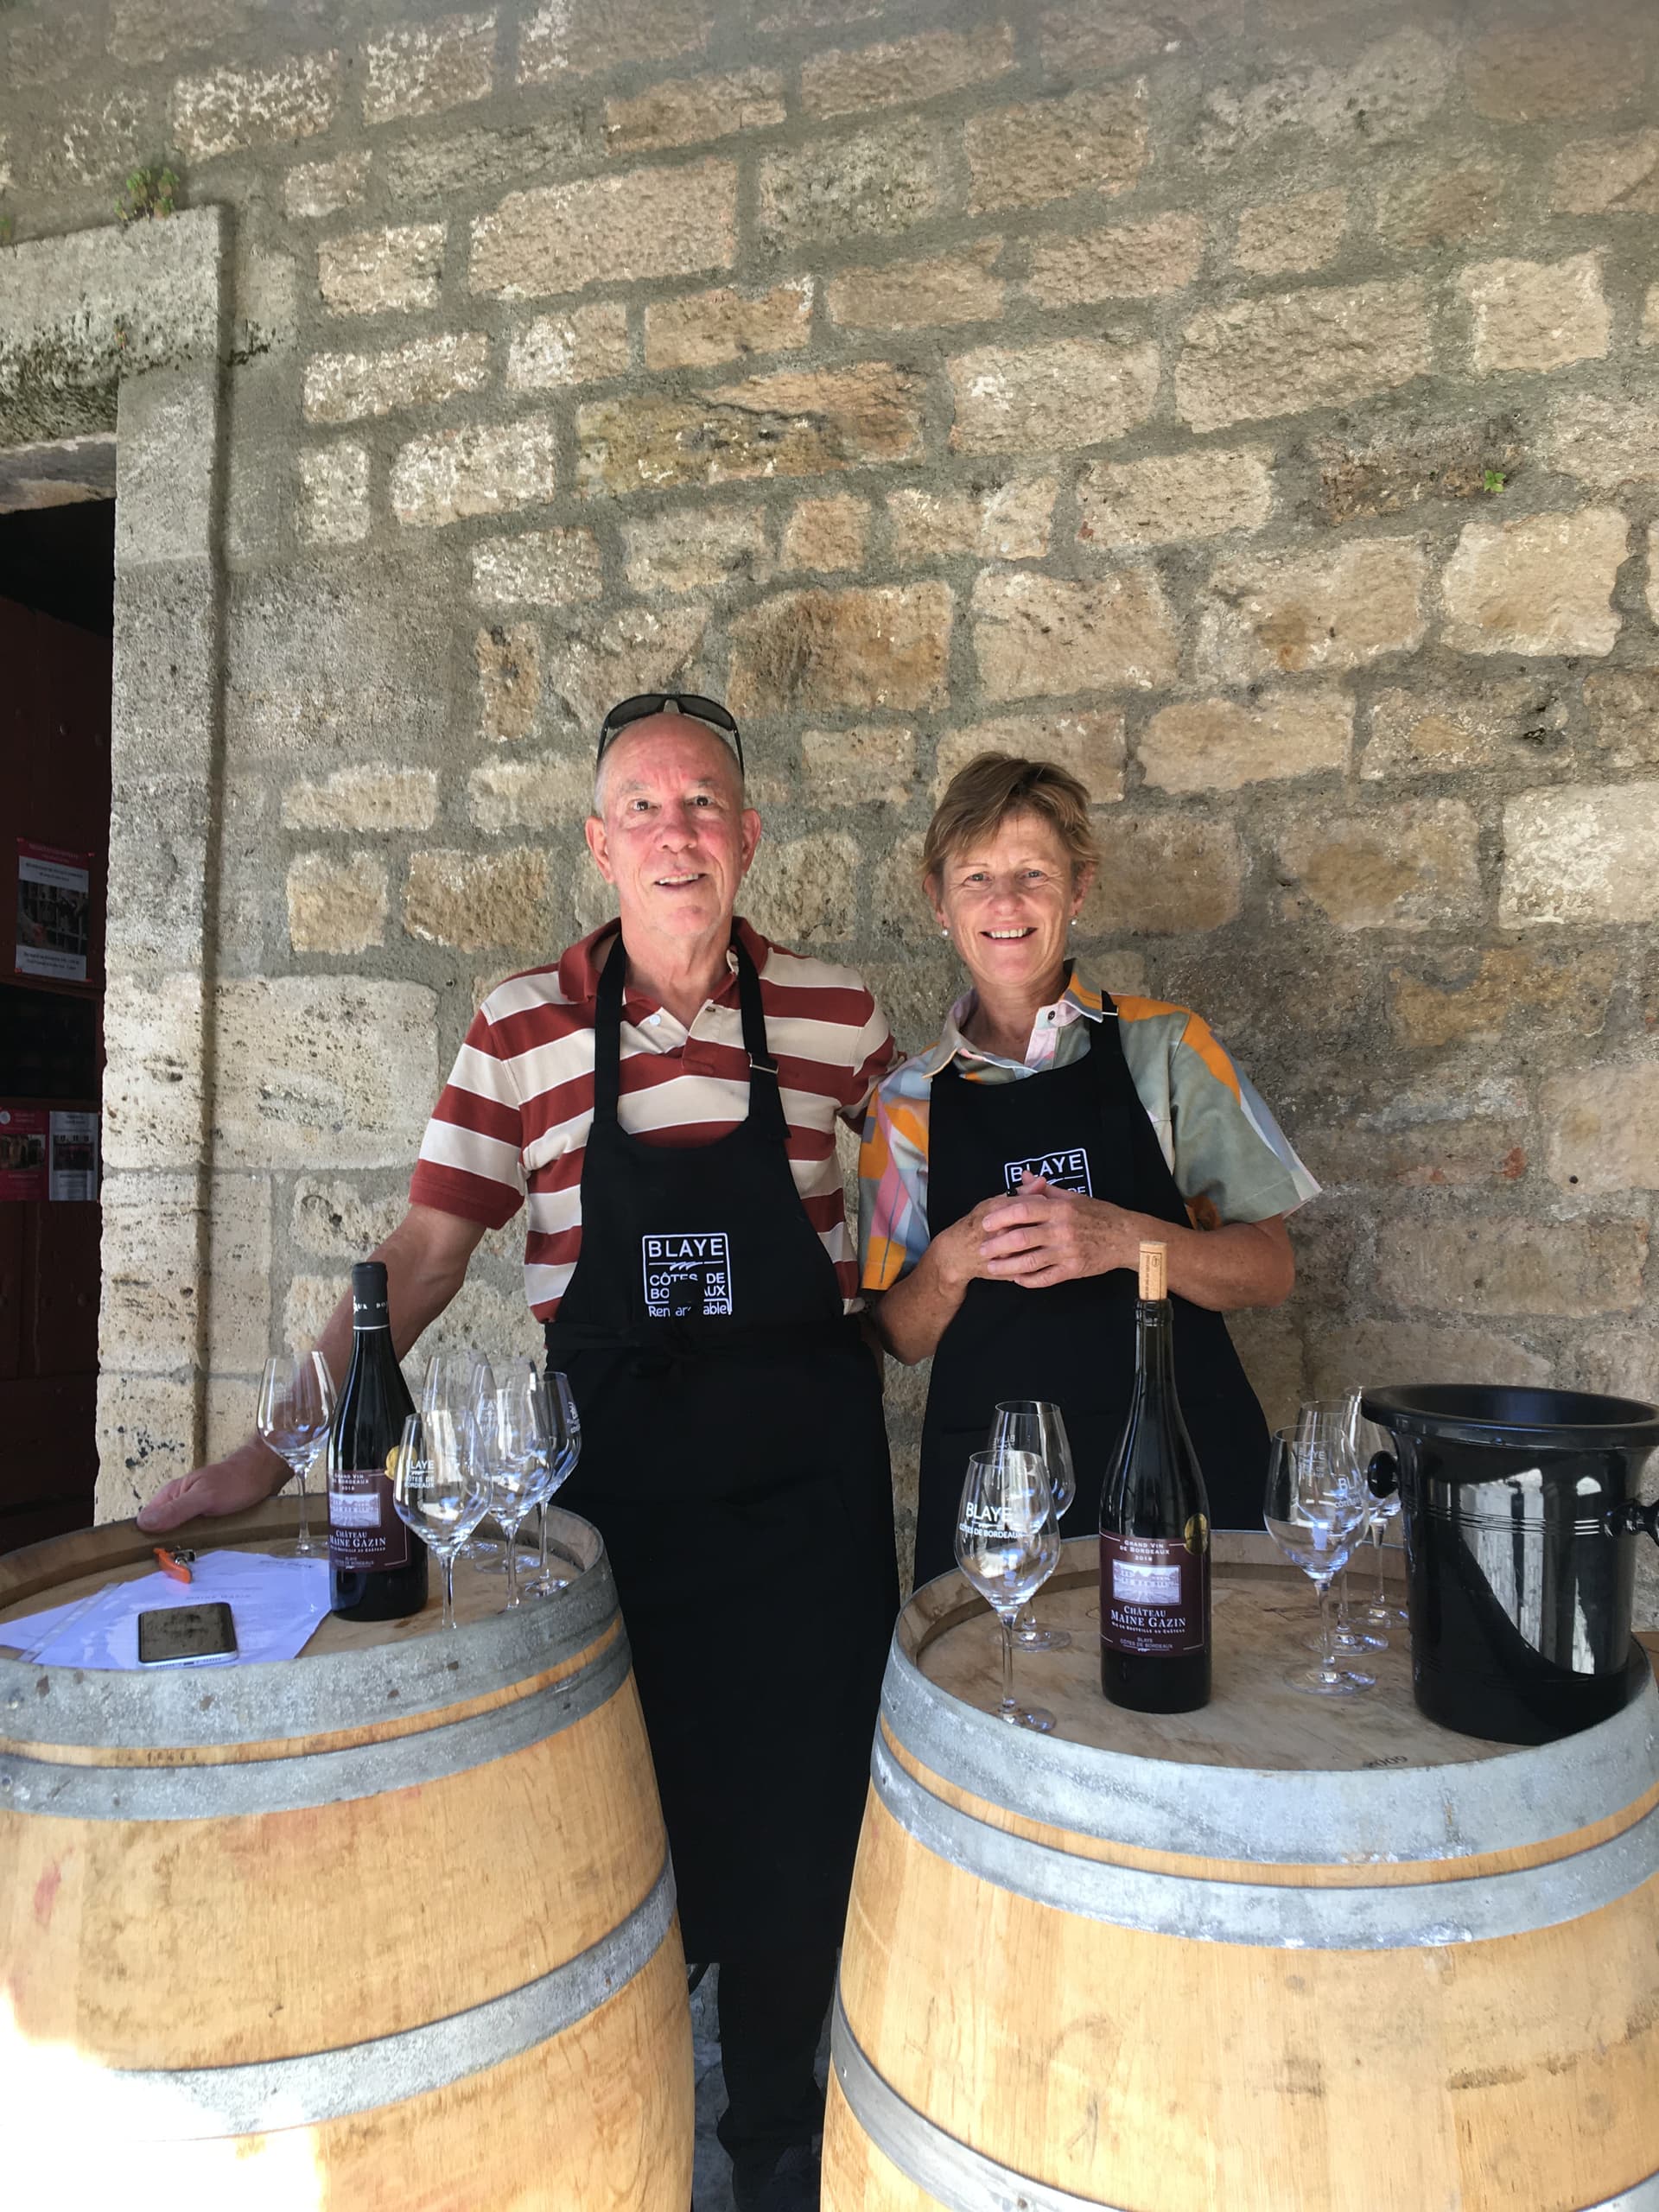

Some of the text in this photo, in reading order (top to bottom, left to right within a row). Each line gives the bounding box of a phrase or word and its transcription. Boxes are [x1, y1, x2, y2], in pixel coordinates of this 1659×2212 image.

[648, 1238, 724, 1257] BLAYE
[706, 1272, 726, 1284] DE
[406, 1459, 435, 1470] LAYE
[966, 1502, 1013, 1522] BLAYE
[353, 1537, 386, 1548] GAZIN
[1124, 1540, 1147, 1548] GRAND
[1129, 1547, 1170, 1555] BORDEAUX
[1110, 1609, 1186, 1628] MAINE GAZIN
